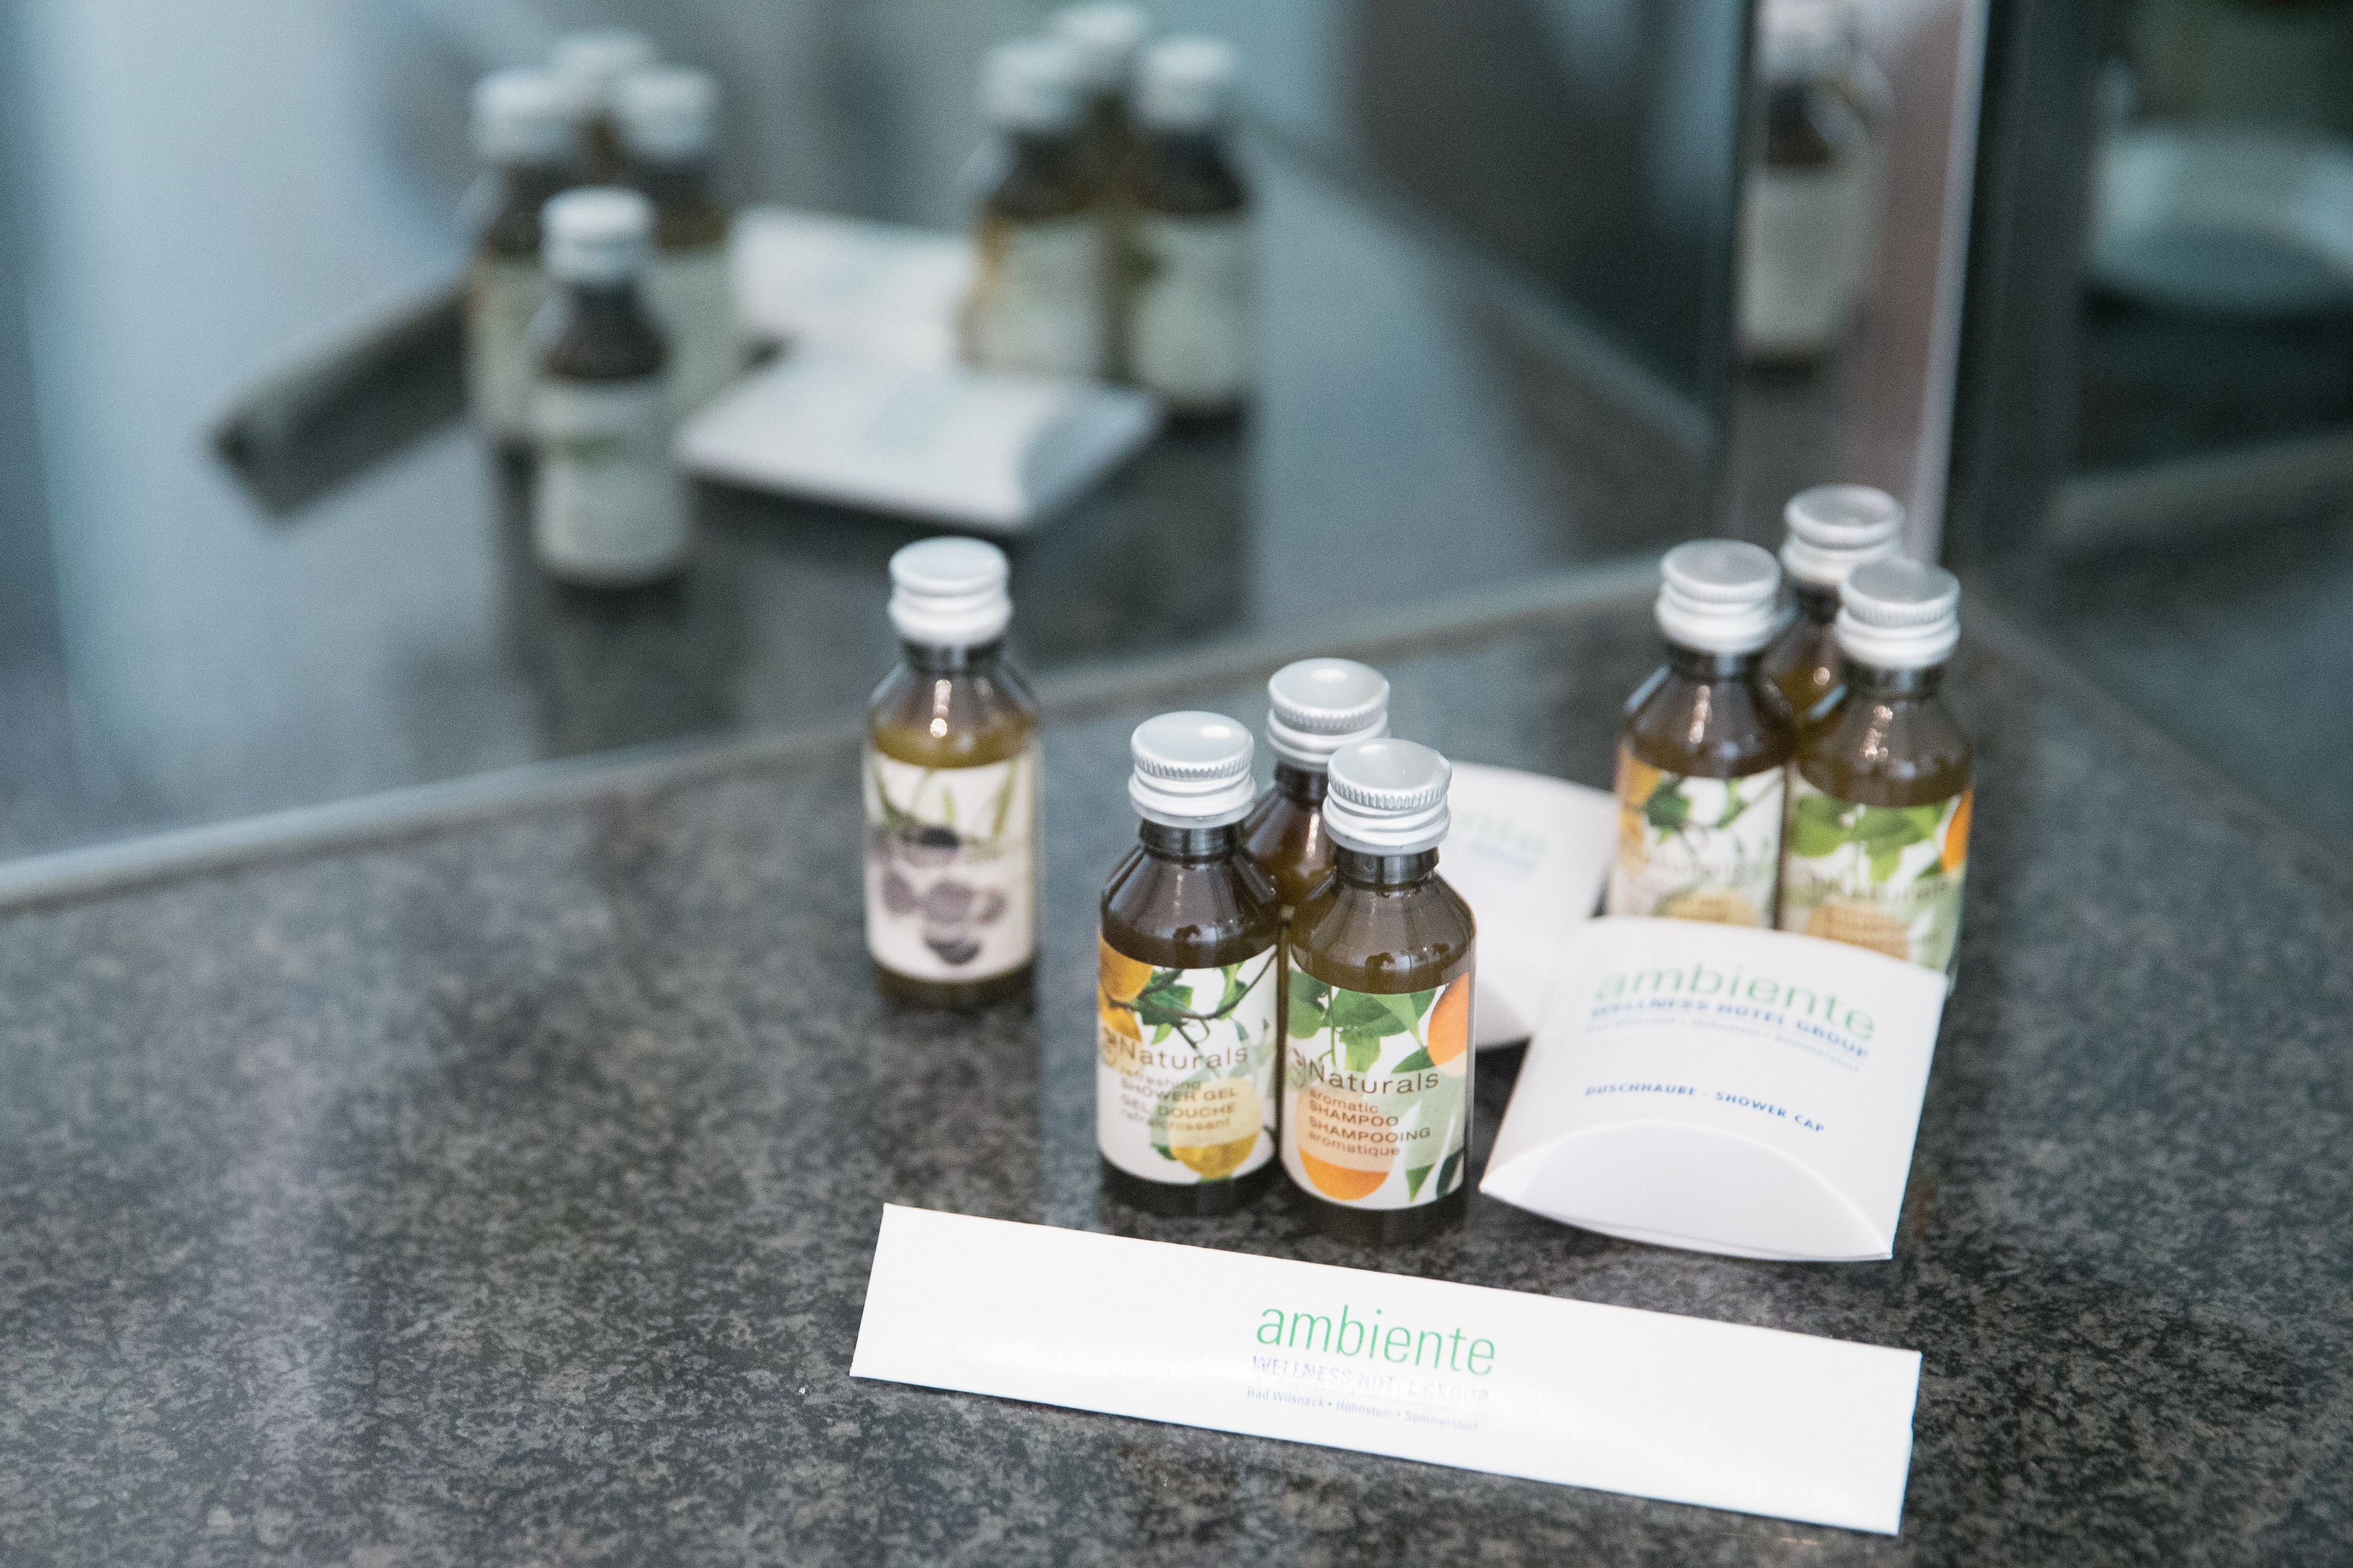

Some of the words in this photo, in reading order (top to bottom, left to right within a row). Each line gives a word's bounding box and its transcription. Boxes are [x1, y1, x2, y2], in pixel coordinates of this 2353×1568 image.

[1596, 962, 1875, 1041] ambiente
[1716, 1002, 1786, 1026] HOTEL
[1120, 1037, 1249, 1070] Naturals
[1121, 1077, 1196, 1102] SHOWER
[1203, 1086, 1237, 1101] GEL
[1308, 1059, 1439, 1095] Naturals
[1157, 1102, 1236, 1118] DOUCHE
[1309, 1088, 1378, 1114] aromatic
[1309, 1099, 1399, 1127] SHAMPOO
[1716, 1091, 1787, 1118] SHOWER
[1794, 1114, 1825, 1132] CAP
[1308, 1115, 1431, 1143] SHAMPOOING
[1308, 1131, 1400, 1159] aromatique
[1256, 1304, 1495, 1376] ambiente
[1246, 1386, 1269, 1400] Bad
[1273, 1390, 1325, 1409] Wilsnack
